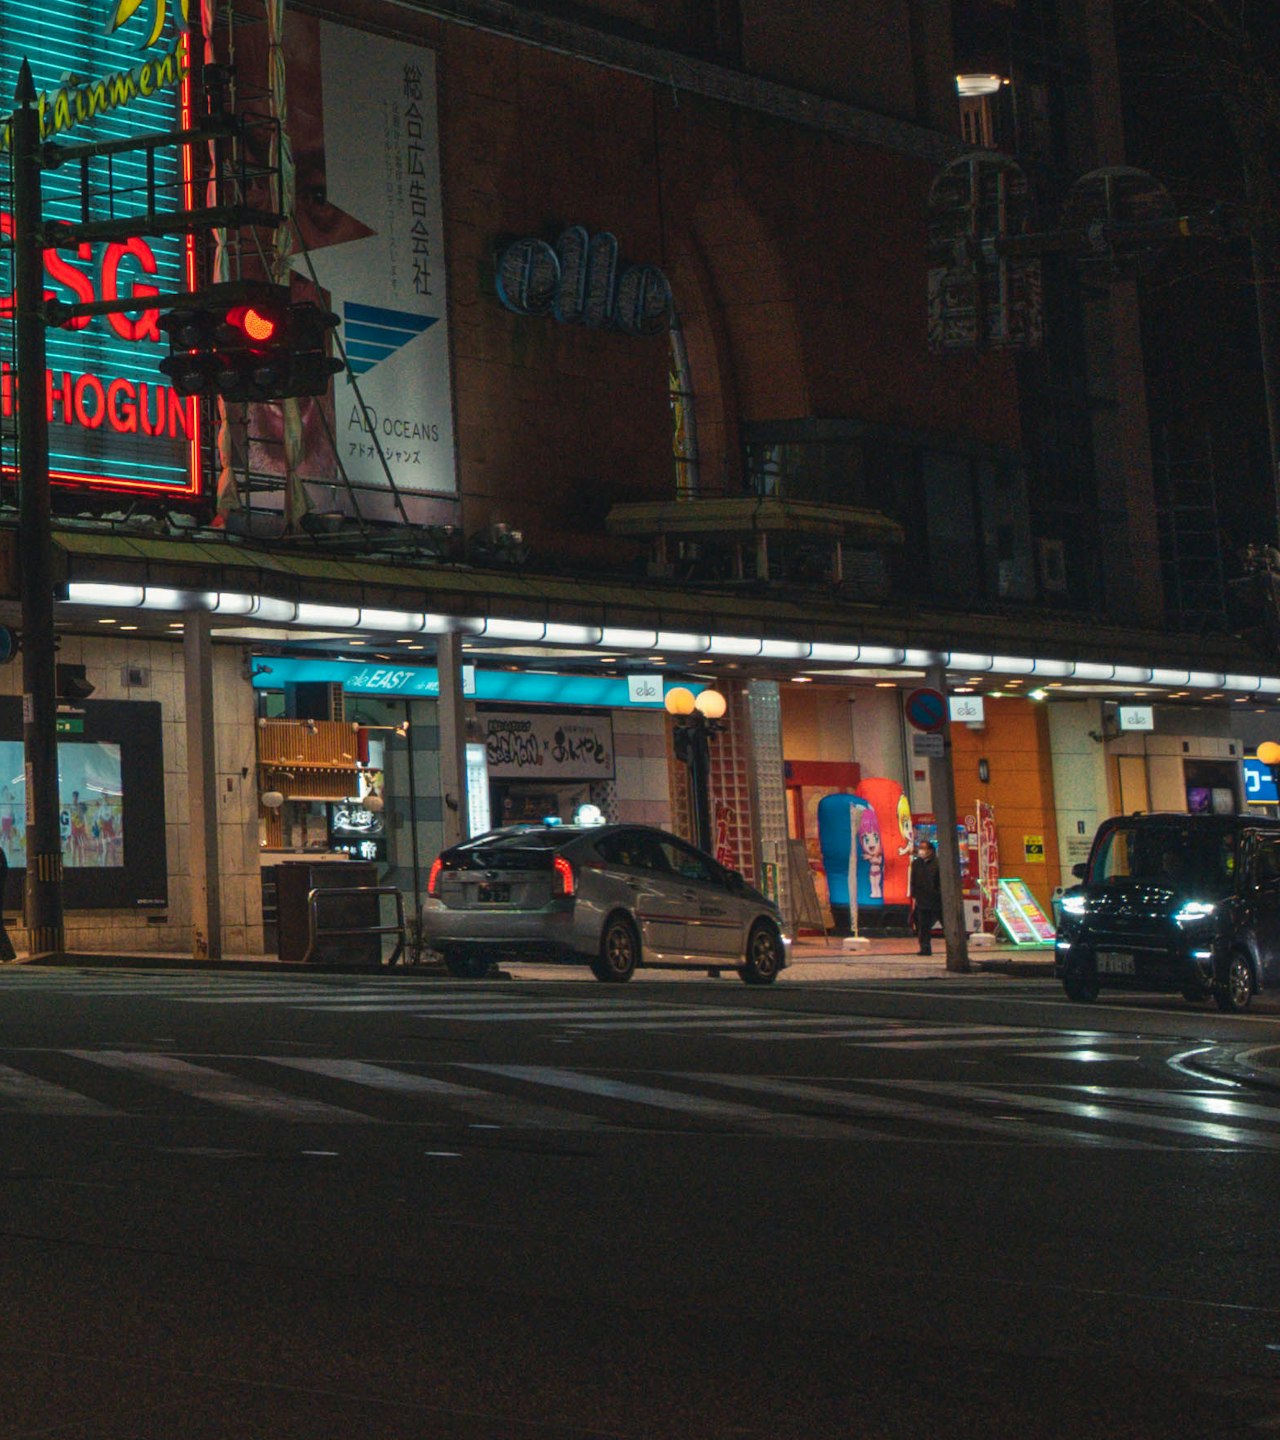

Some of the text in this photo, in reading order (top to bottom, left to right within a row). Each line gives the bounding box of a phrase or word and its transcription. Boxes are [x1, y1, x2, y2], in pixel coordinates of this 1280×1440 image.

[403, 64, 432, 296] 総合広告会社
[348, 405, 439, 442] AD OCEANS
[366, 670, 416, 689] EAST
